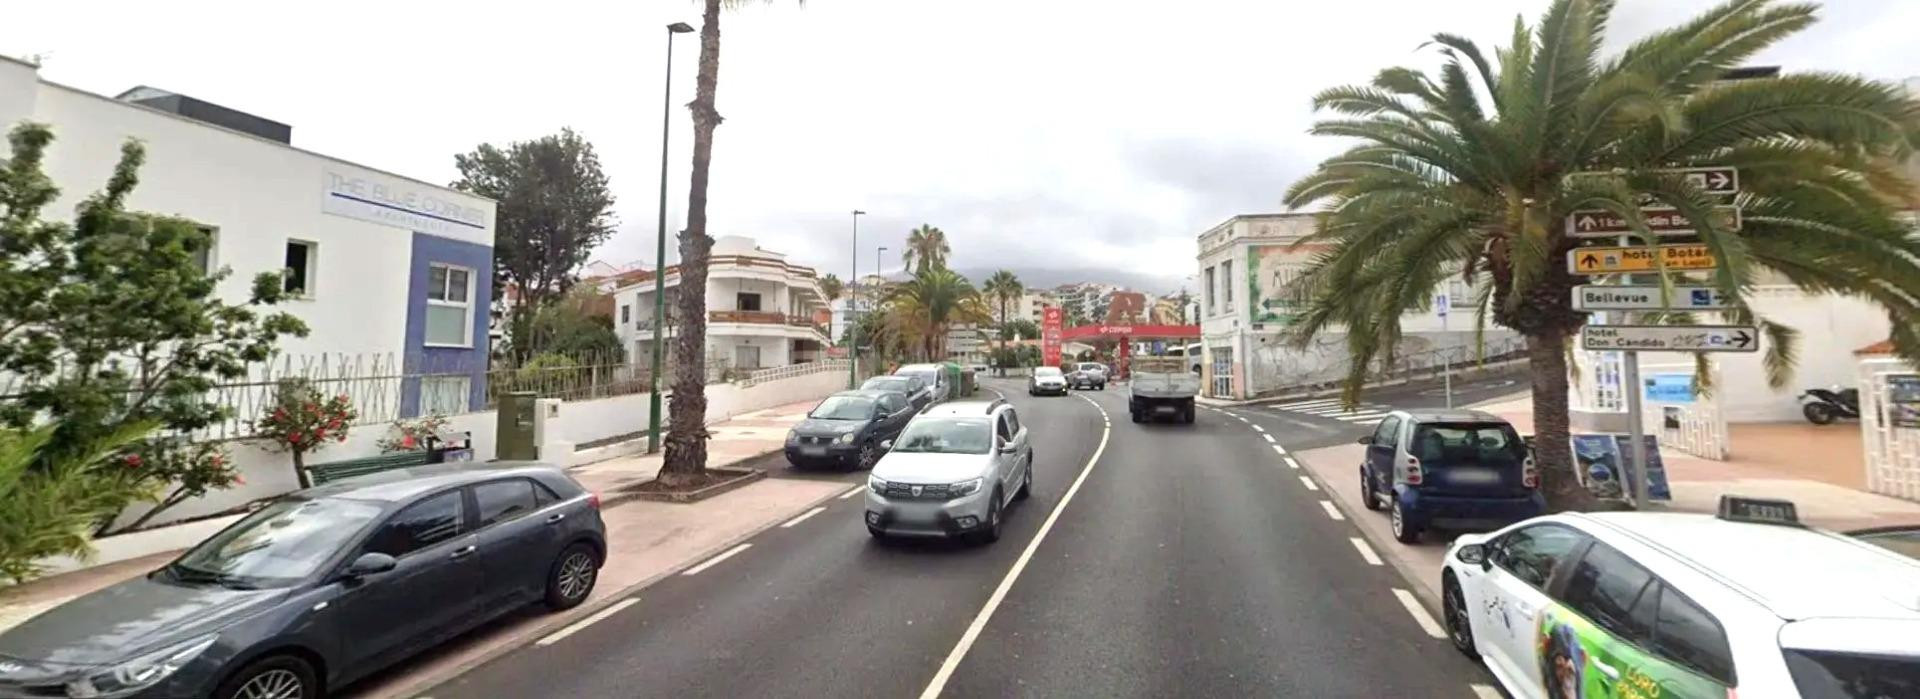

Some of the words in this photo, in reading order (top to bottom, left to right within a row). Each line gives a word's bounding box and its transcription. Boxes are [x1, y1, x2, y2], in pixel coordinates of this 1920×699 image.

[328, 171, 365, 196] THE
[372, 182, 417, 209] BLUE
[423, 196, 487, 225] CORNER
[1586, 292, 1649, 304] Bellevue
[1587, 329, 1617, 337] hotel
[1587, 338, 1609, 346] Don
